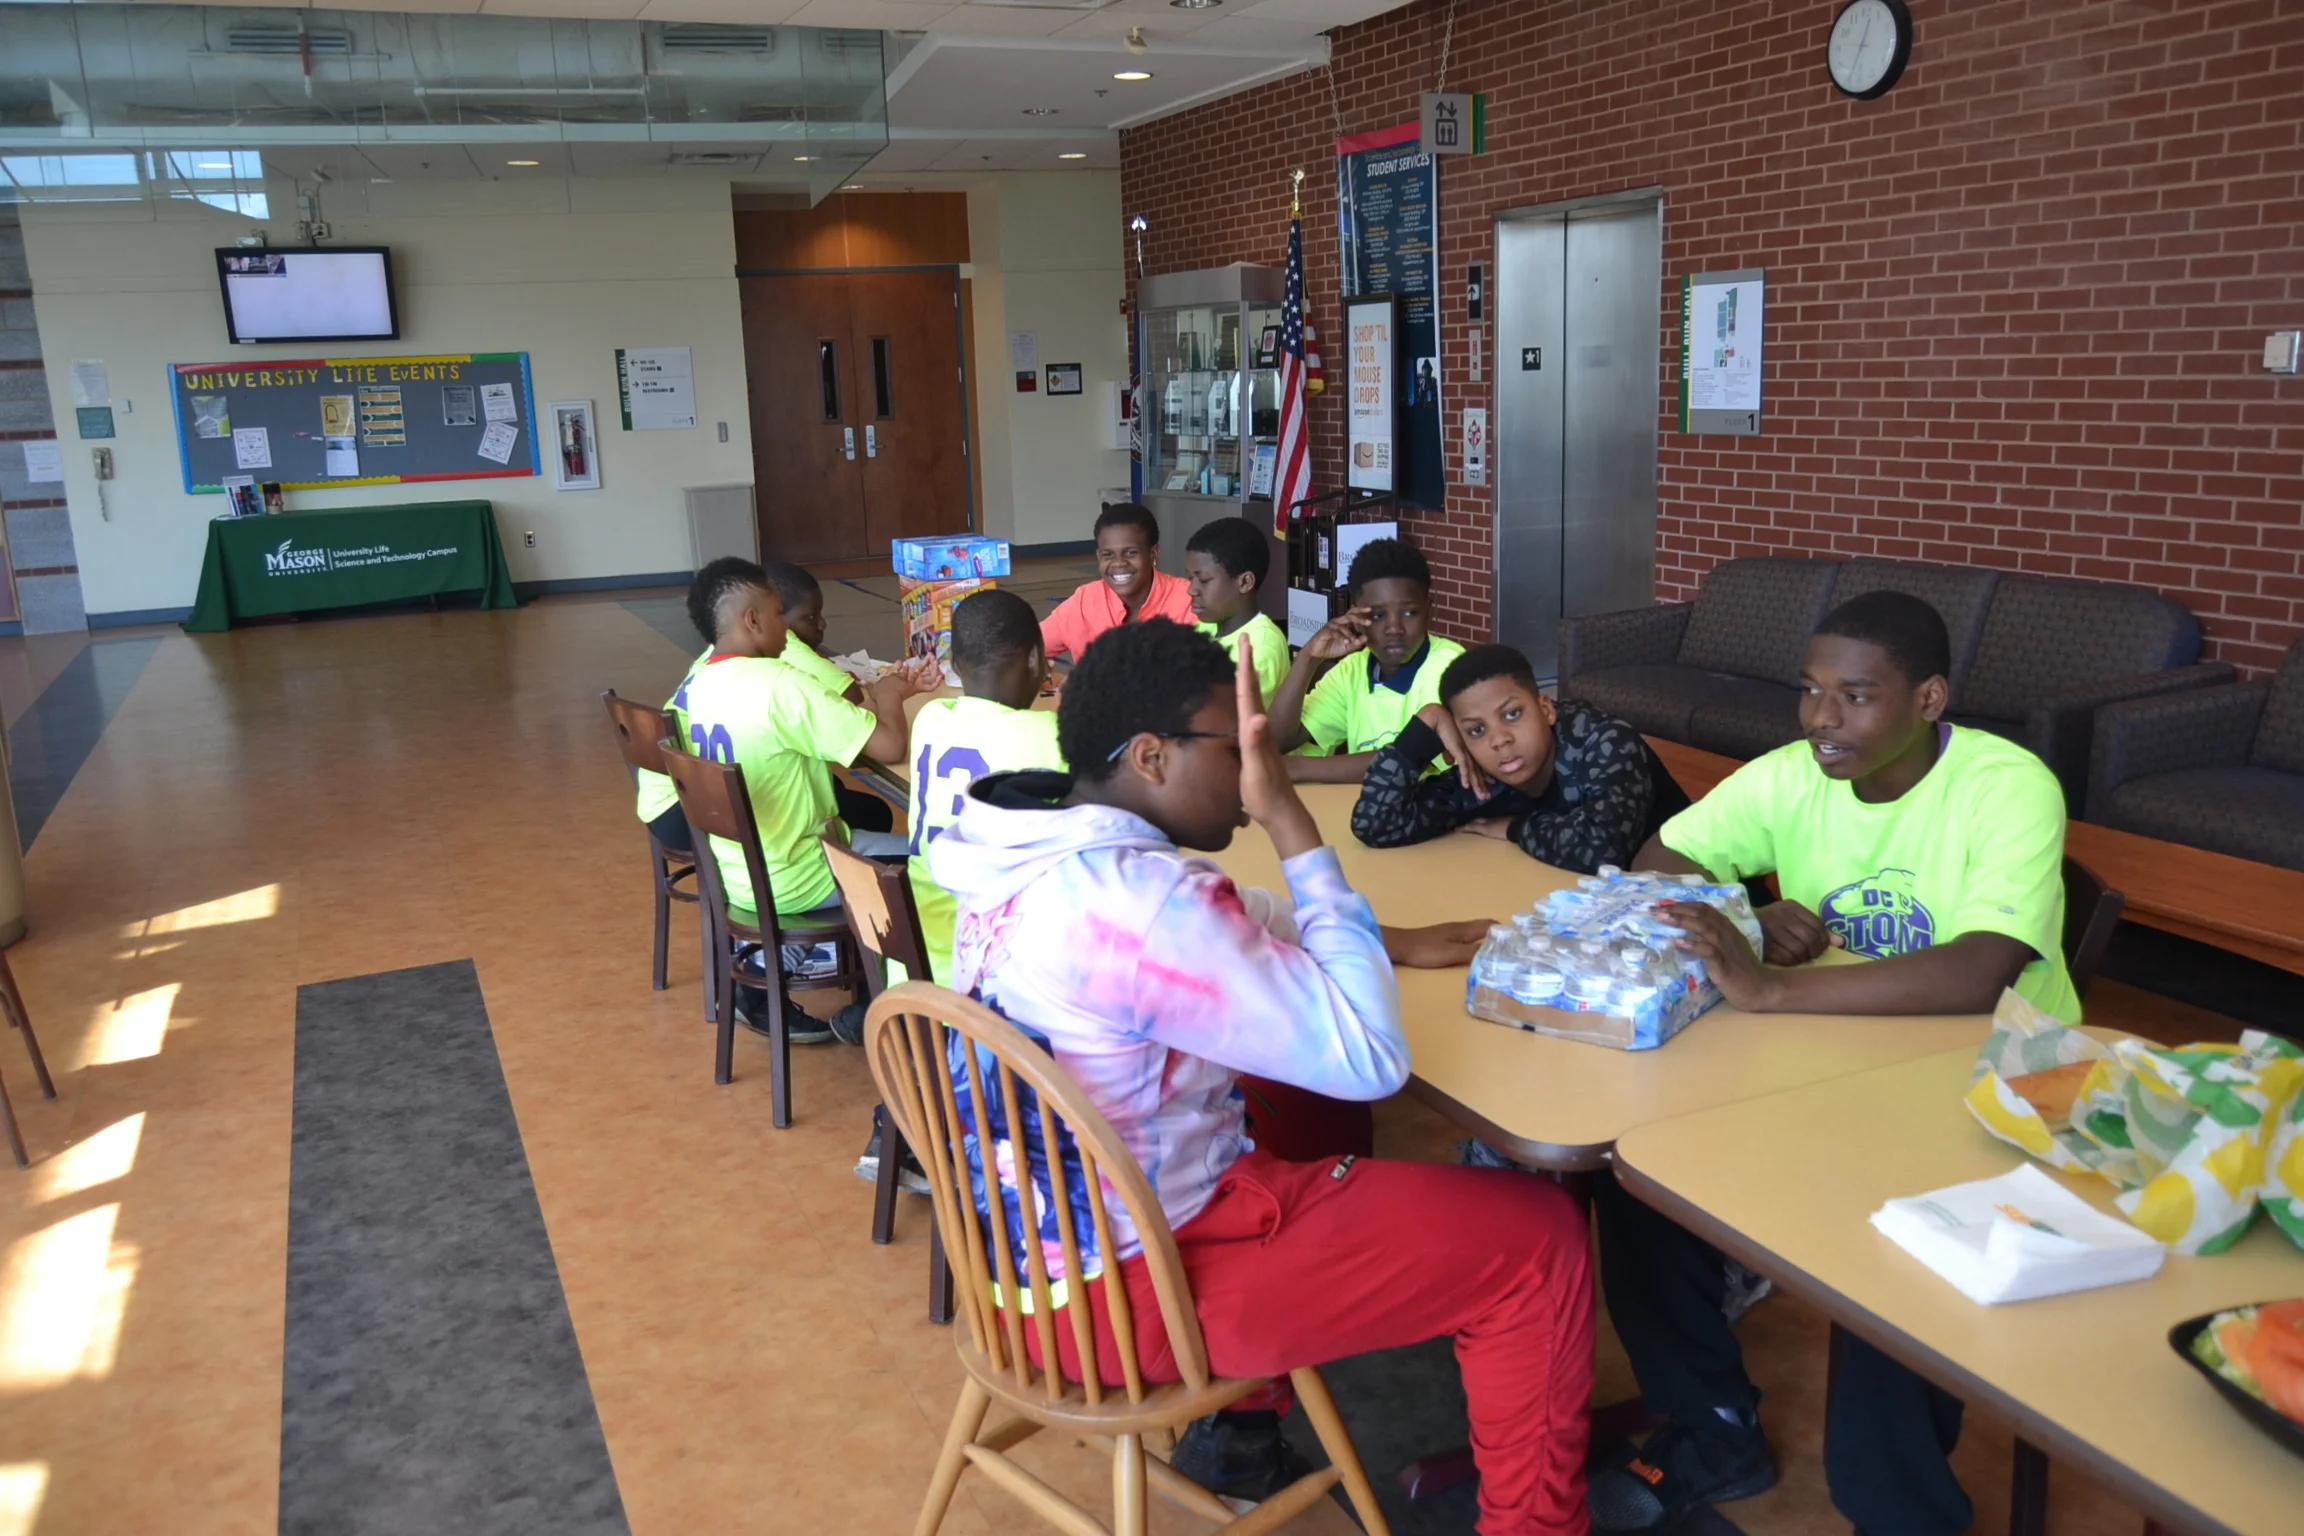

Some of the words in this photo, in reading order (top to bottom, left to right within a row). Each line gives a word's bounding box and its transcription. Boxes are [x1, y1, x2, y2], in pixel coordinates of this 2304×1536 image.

[1366, 159, 1398, 178] STUDENT
[1398, 152, 1431, 172] SERVICES
[1354, 325, 1374, 342] SHOP
[1353, 345, 1375, 363] YOUR
[1682, 351, 1690, 380] BULL
[1354, 366, 1381, 384] MOUSE
[1353, 386, 1380, 404] DROPS
[688, 415, 694, 426] 1
[1747, 412, 1755, 432] 1
[286, 548, 324, 558] GEORGE
[332, 547, 373, 558] University
[374, 545, 390, 553] Life
[334, 558, 365, 568] Science
[366, 556, 382, 565] and
[382, 552, 426, 564] Technology
[427, 546, 458, 558] Campus
[265, 552, 326, 571] MASON
[268, 566, 327, 577] UNIVERSITY
[1861, 888, 1894, 910] DC
